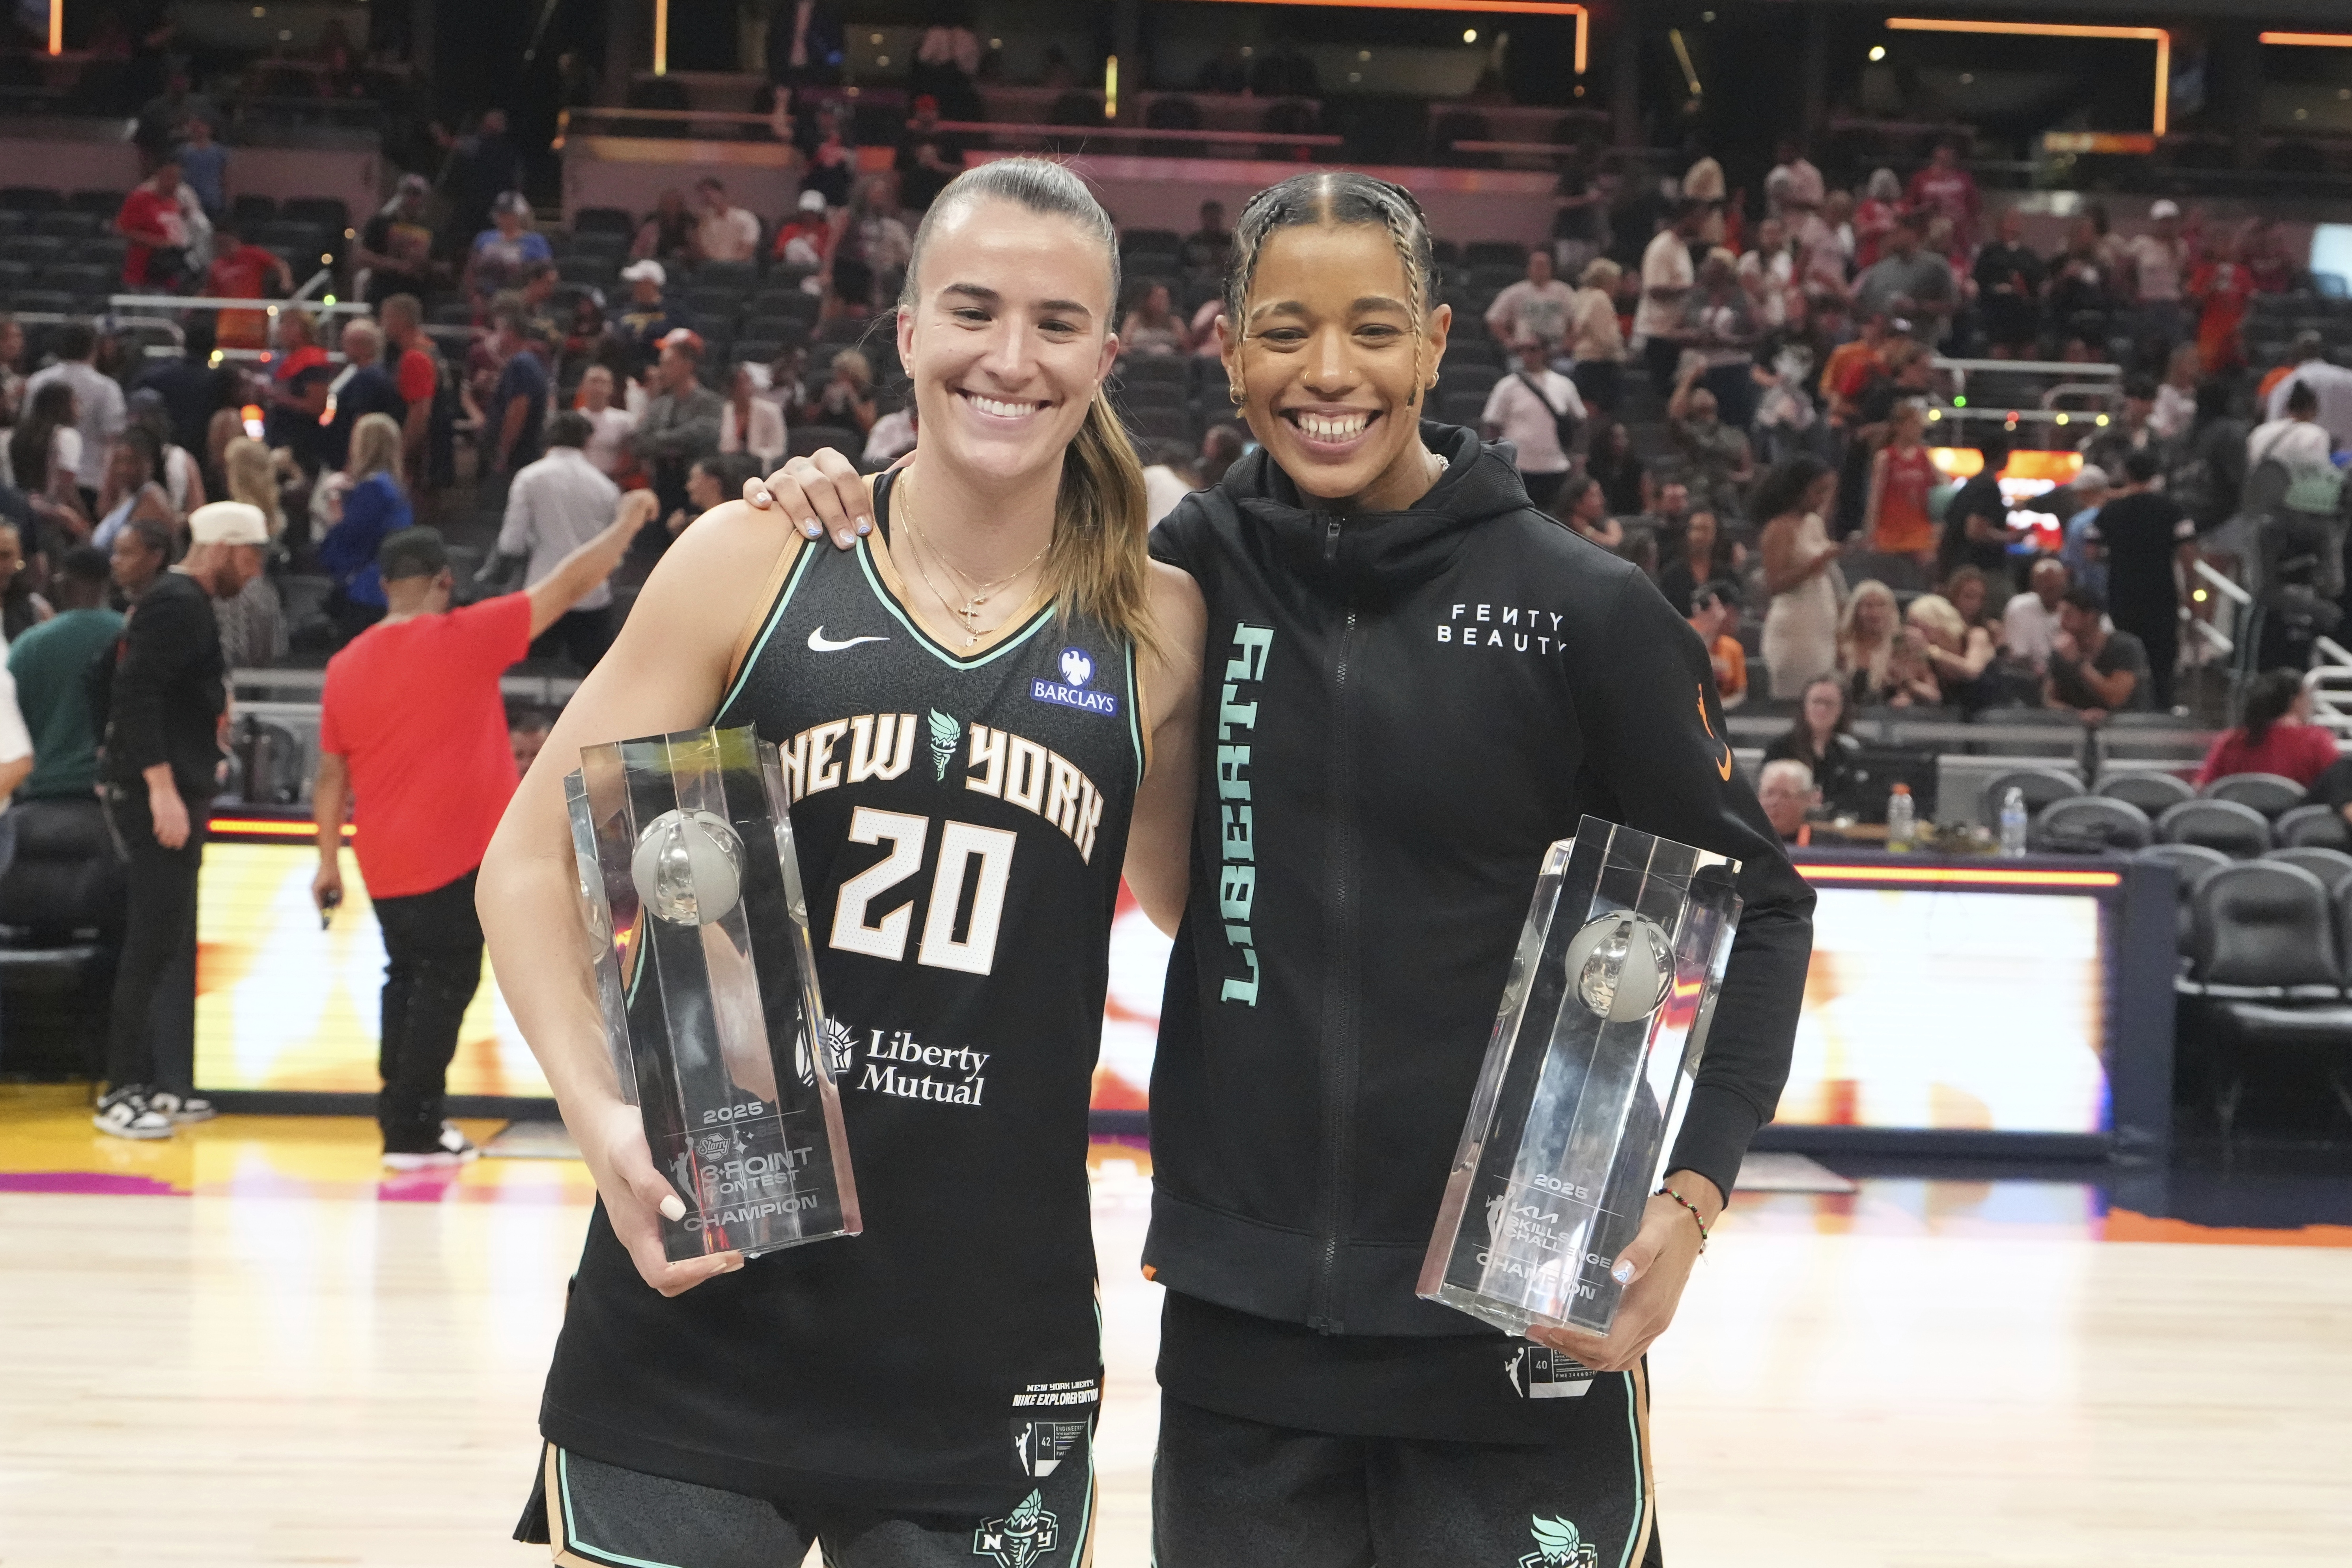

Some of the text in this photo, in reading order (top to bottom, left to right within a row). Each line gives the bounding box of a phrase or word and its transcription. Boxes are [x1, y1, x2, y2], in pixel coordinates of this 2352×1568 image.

[1034, 682, 1114, 712] BARCLAYS
[779, 713, 1104, 866] NEW YORK
[1217, 623, 1274, 1007] LIBERTY
[829, 806, 1017, 976] 20
[867, 1029, 990, 1082] Liberty
[857, 1064, 985, 1106] Mutual
[703, 1101, 763, 1124] 2025
[697, 1138, 730, 1155] Starry
[1534, 1174, 1589, 1199] 2025
[683, 1195, 818, 1231] CHAMPION
[1506, 1216, 1571, 1242] SKILLS
[1503, 1223, 1612, 1269] CHALLENGE
[1476, 1253, 1596, 1300] CHAMPON
[1536, 1360, 1547, 1370] 40
[1012, 1388, 1098, 1406] NIKE EXPLORER EDITION
[1049, 1382, 1070, 1391] YORK
[1071, 1379, 1094, 1389] LIBERTY
[1041, 1437, 1051, 1447] 42
